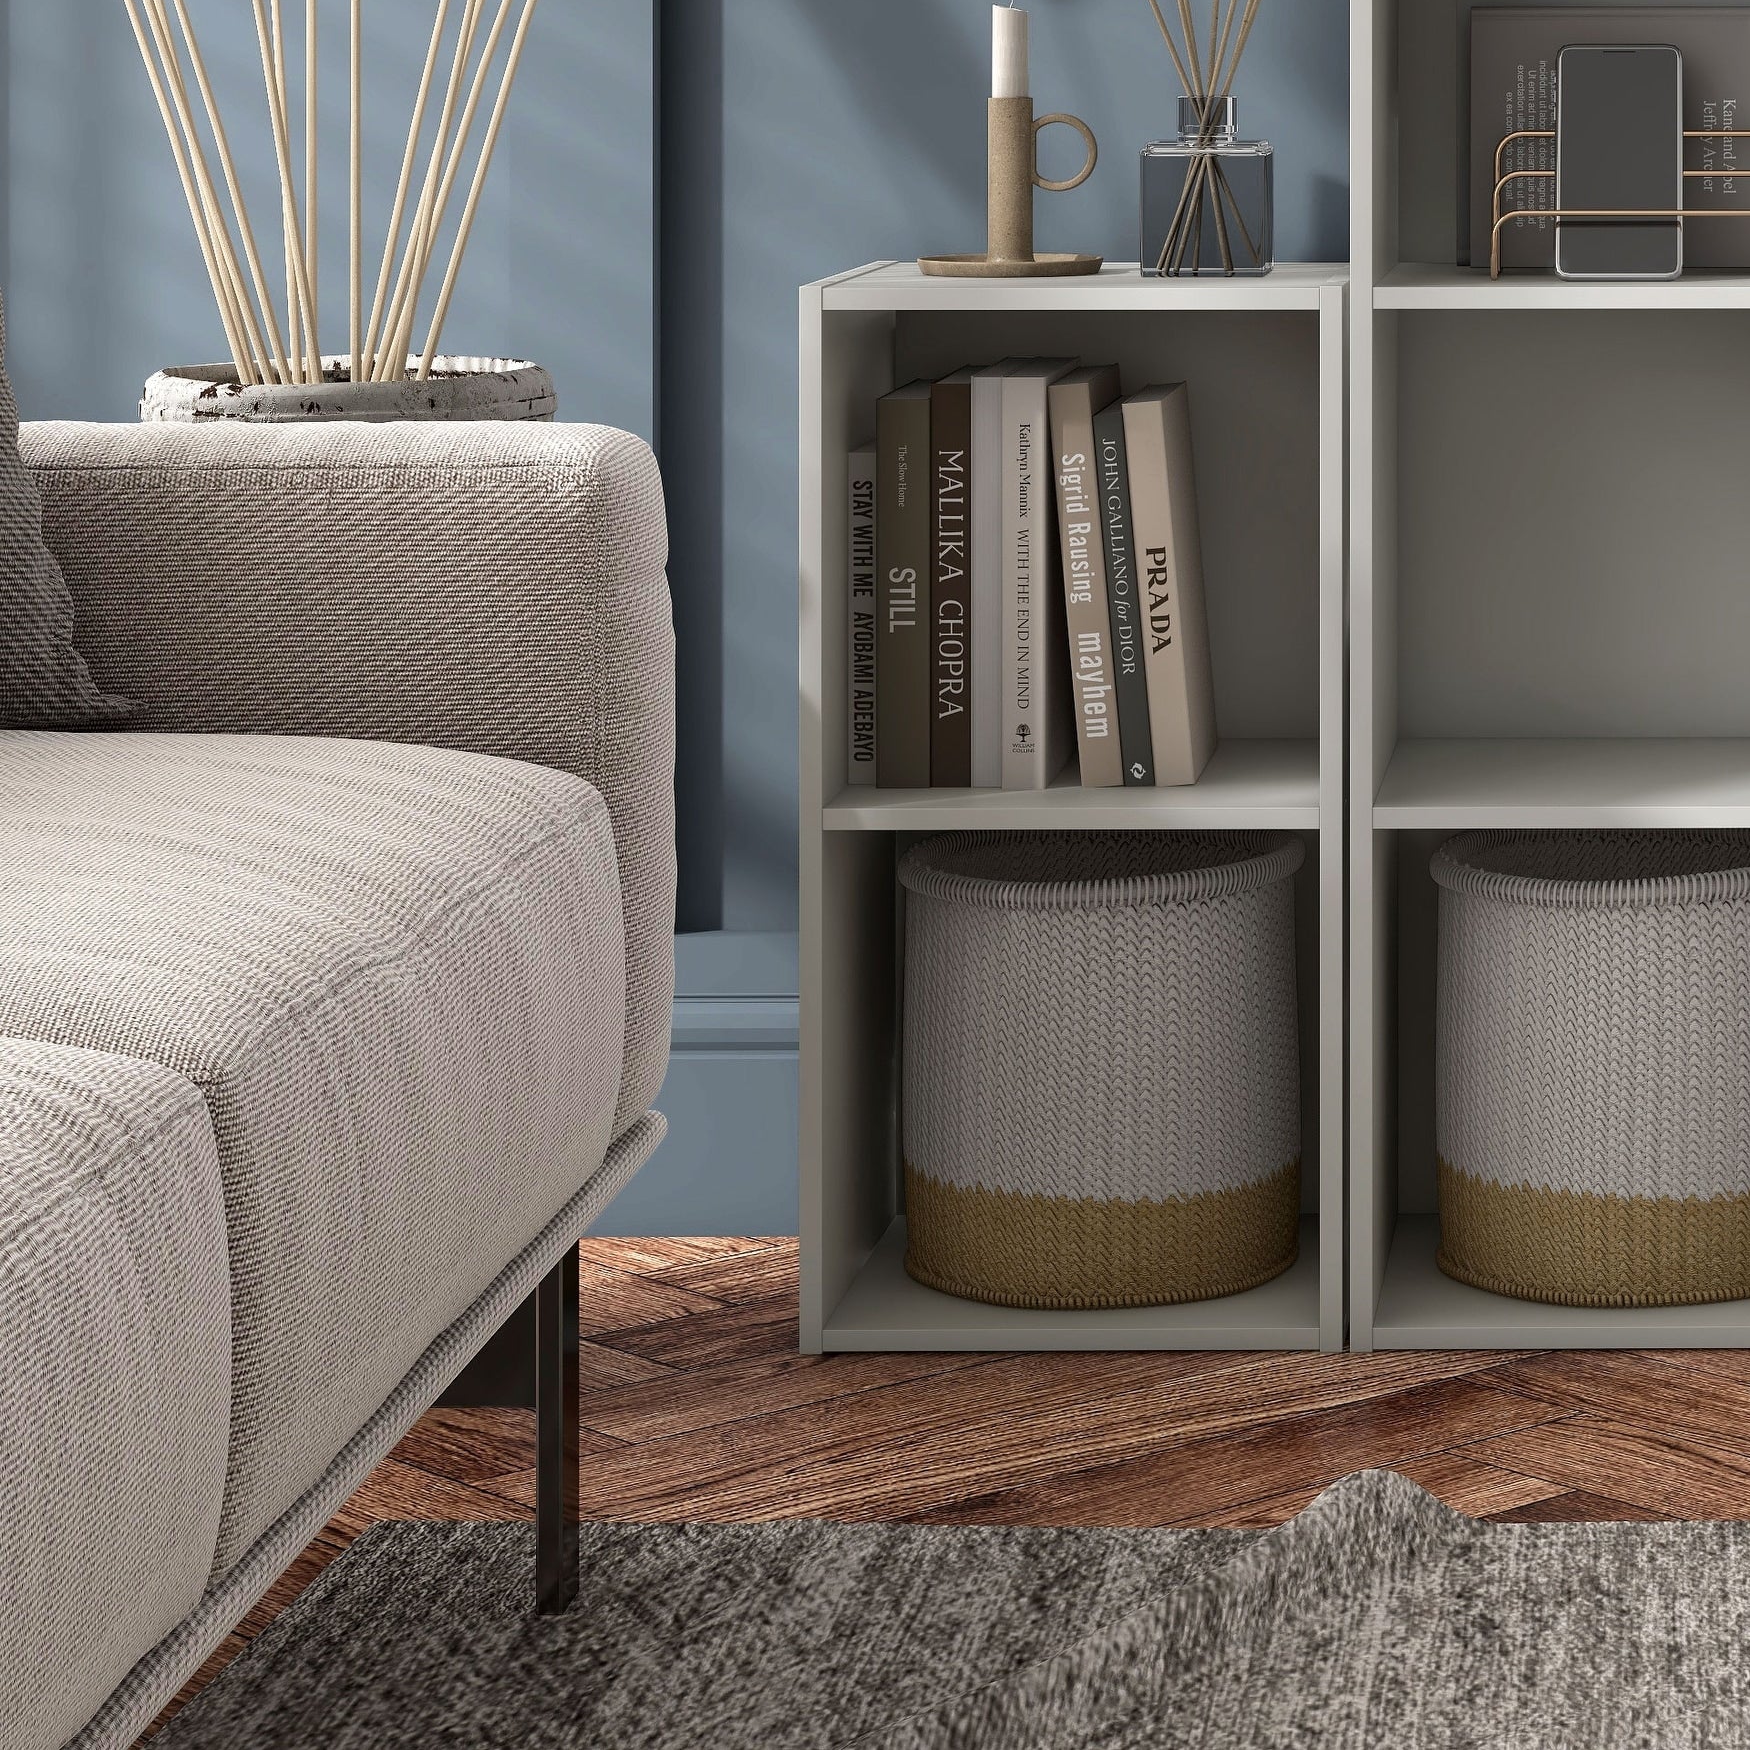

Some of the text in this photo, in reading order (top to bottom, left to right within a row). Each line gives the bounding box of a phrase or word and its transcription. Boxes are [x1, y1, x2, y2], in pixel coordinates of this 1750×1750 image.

[1701, 100, 1717, 144] Jeffry
[1723, 136, 1737, 160] and
[898, 445, 908, 508] The Slow Home
[1102, 438, 1136, 675] JOHN GALLIANO for DIOR
[852, 480, 874, 762] STAY WITH ME AYOBAMI ADEBAYO
[889, 567, 917, 633] STILL
[938, 450, 964, 719] MALLIKA CHOPRA
[1016, 423, 1031, 710] Kathryn Mannix WITH THE END IN MIND
[1059, 452, 1112, 738] Sigrid Rausing mayhem
[1146, 546, 1172, 655] PRADA
